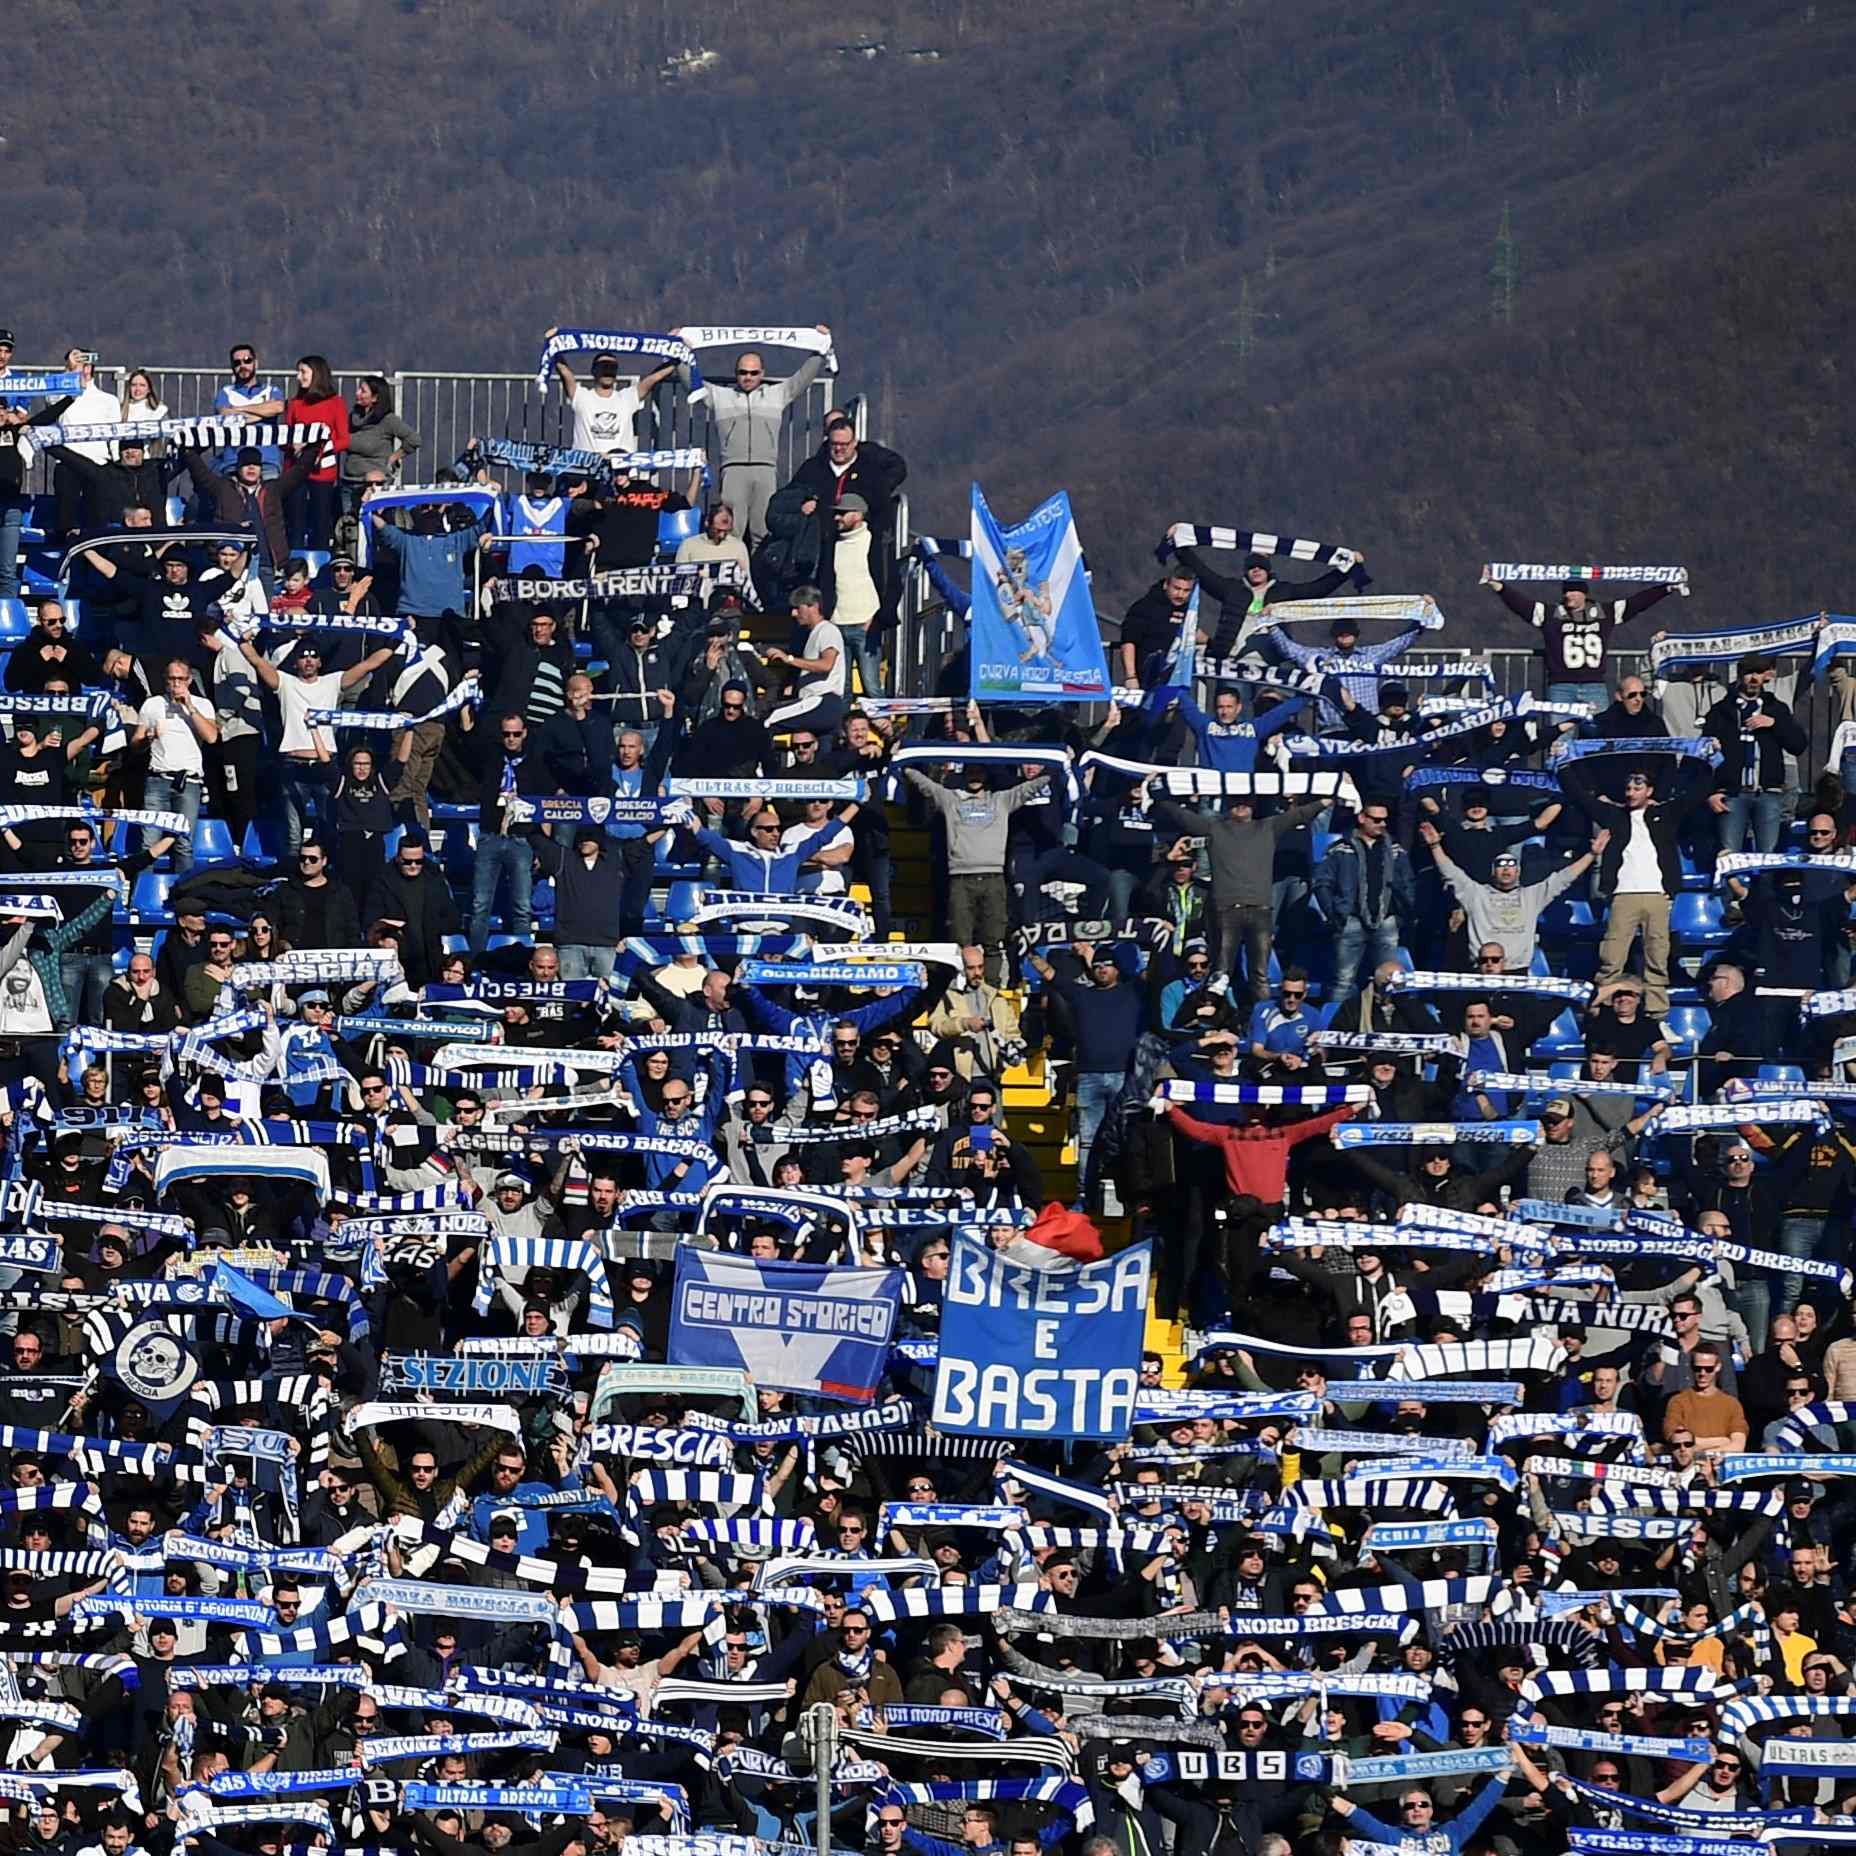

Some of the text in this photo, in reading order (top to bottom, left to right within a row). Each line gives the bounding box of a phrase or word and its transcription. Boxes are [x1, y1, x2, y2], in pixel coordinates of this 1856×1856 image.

[1564, 634, 1603, 669] 69
[1054, 668, 1102, 684] BRESCIA
[953, 1234, 1148, 1314] BRESA
[686, 1290, 781, 1324] CENTRO
[1034, 1319, 1057, 1358] E
[402, 1358, 553, 1389] SEZIONE
[933, 1359, 1139, 1432] BASTA
